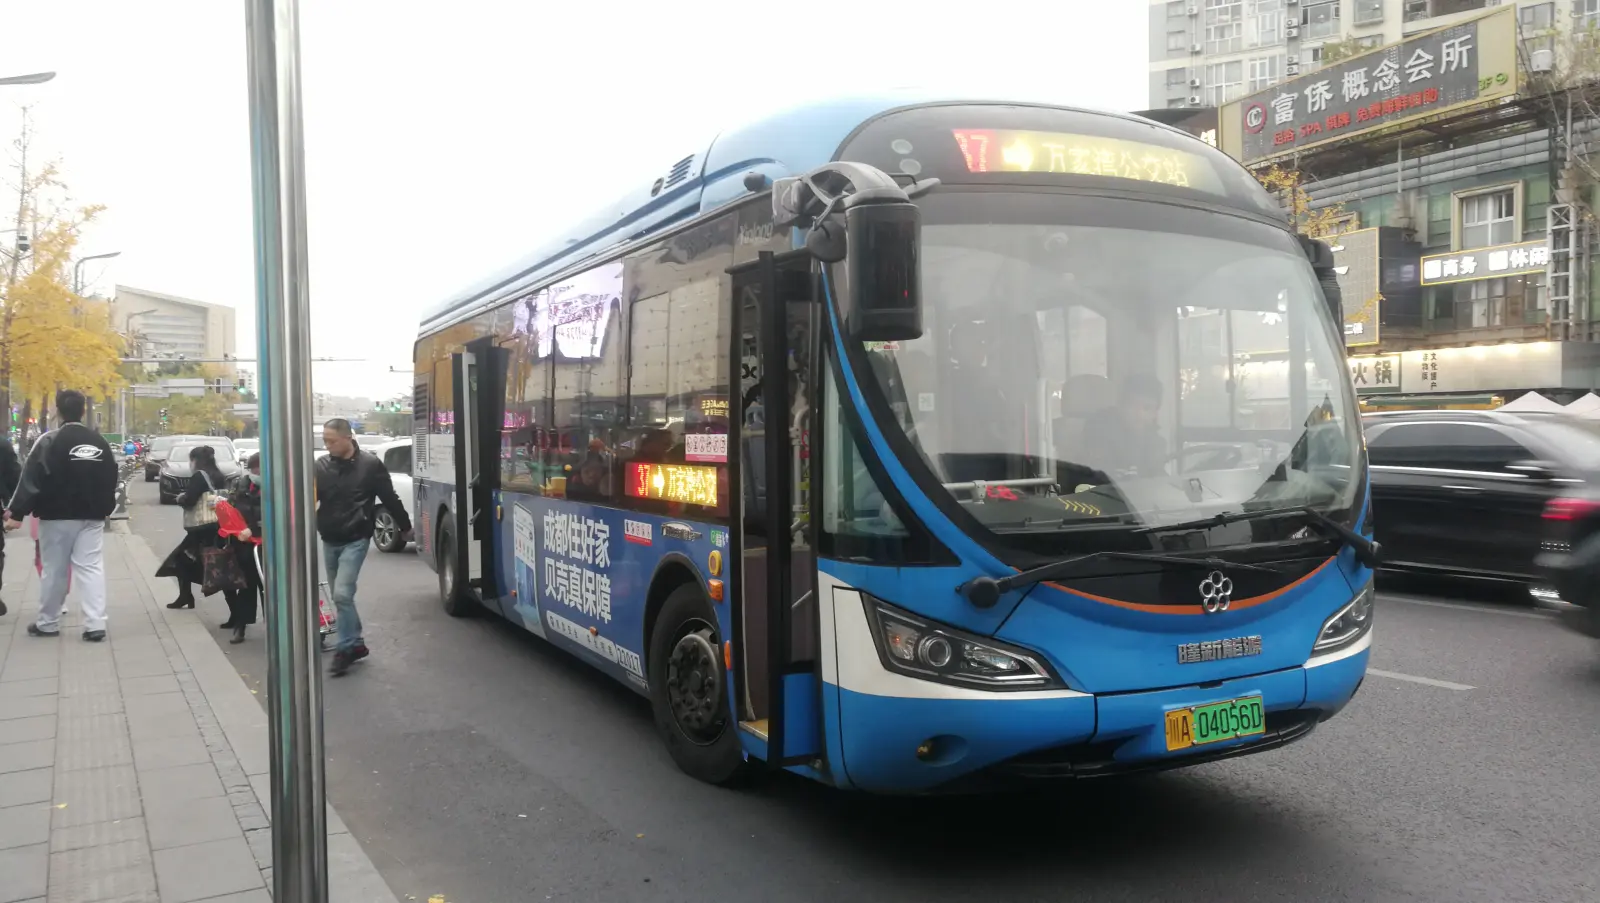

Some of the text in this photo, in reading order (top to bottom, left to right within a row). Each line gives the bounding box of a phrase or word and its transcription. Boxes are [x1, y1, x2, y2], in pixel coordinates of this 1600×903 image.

[1270, 34, 1473, 126] 富侨概念会所
[1299, 122, 1323, 138] SPA
[1352, 360, 1393, 386] 火锅
[543, 509, 611, 568] 成都住好家
[544, 556, 612, 624] 贝壳真保障
